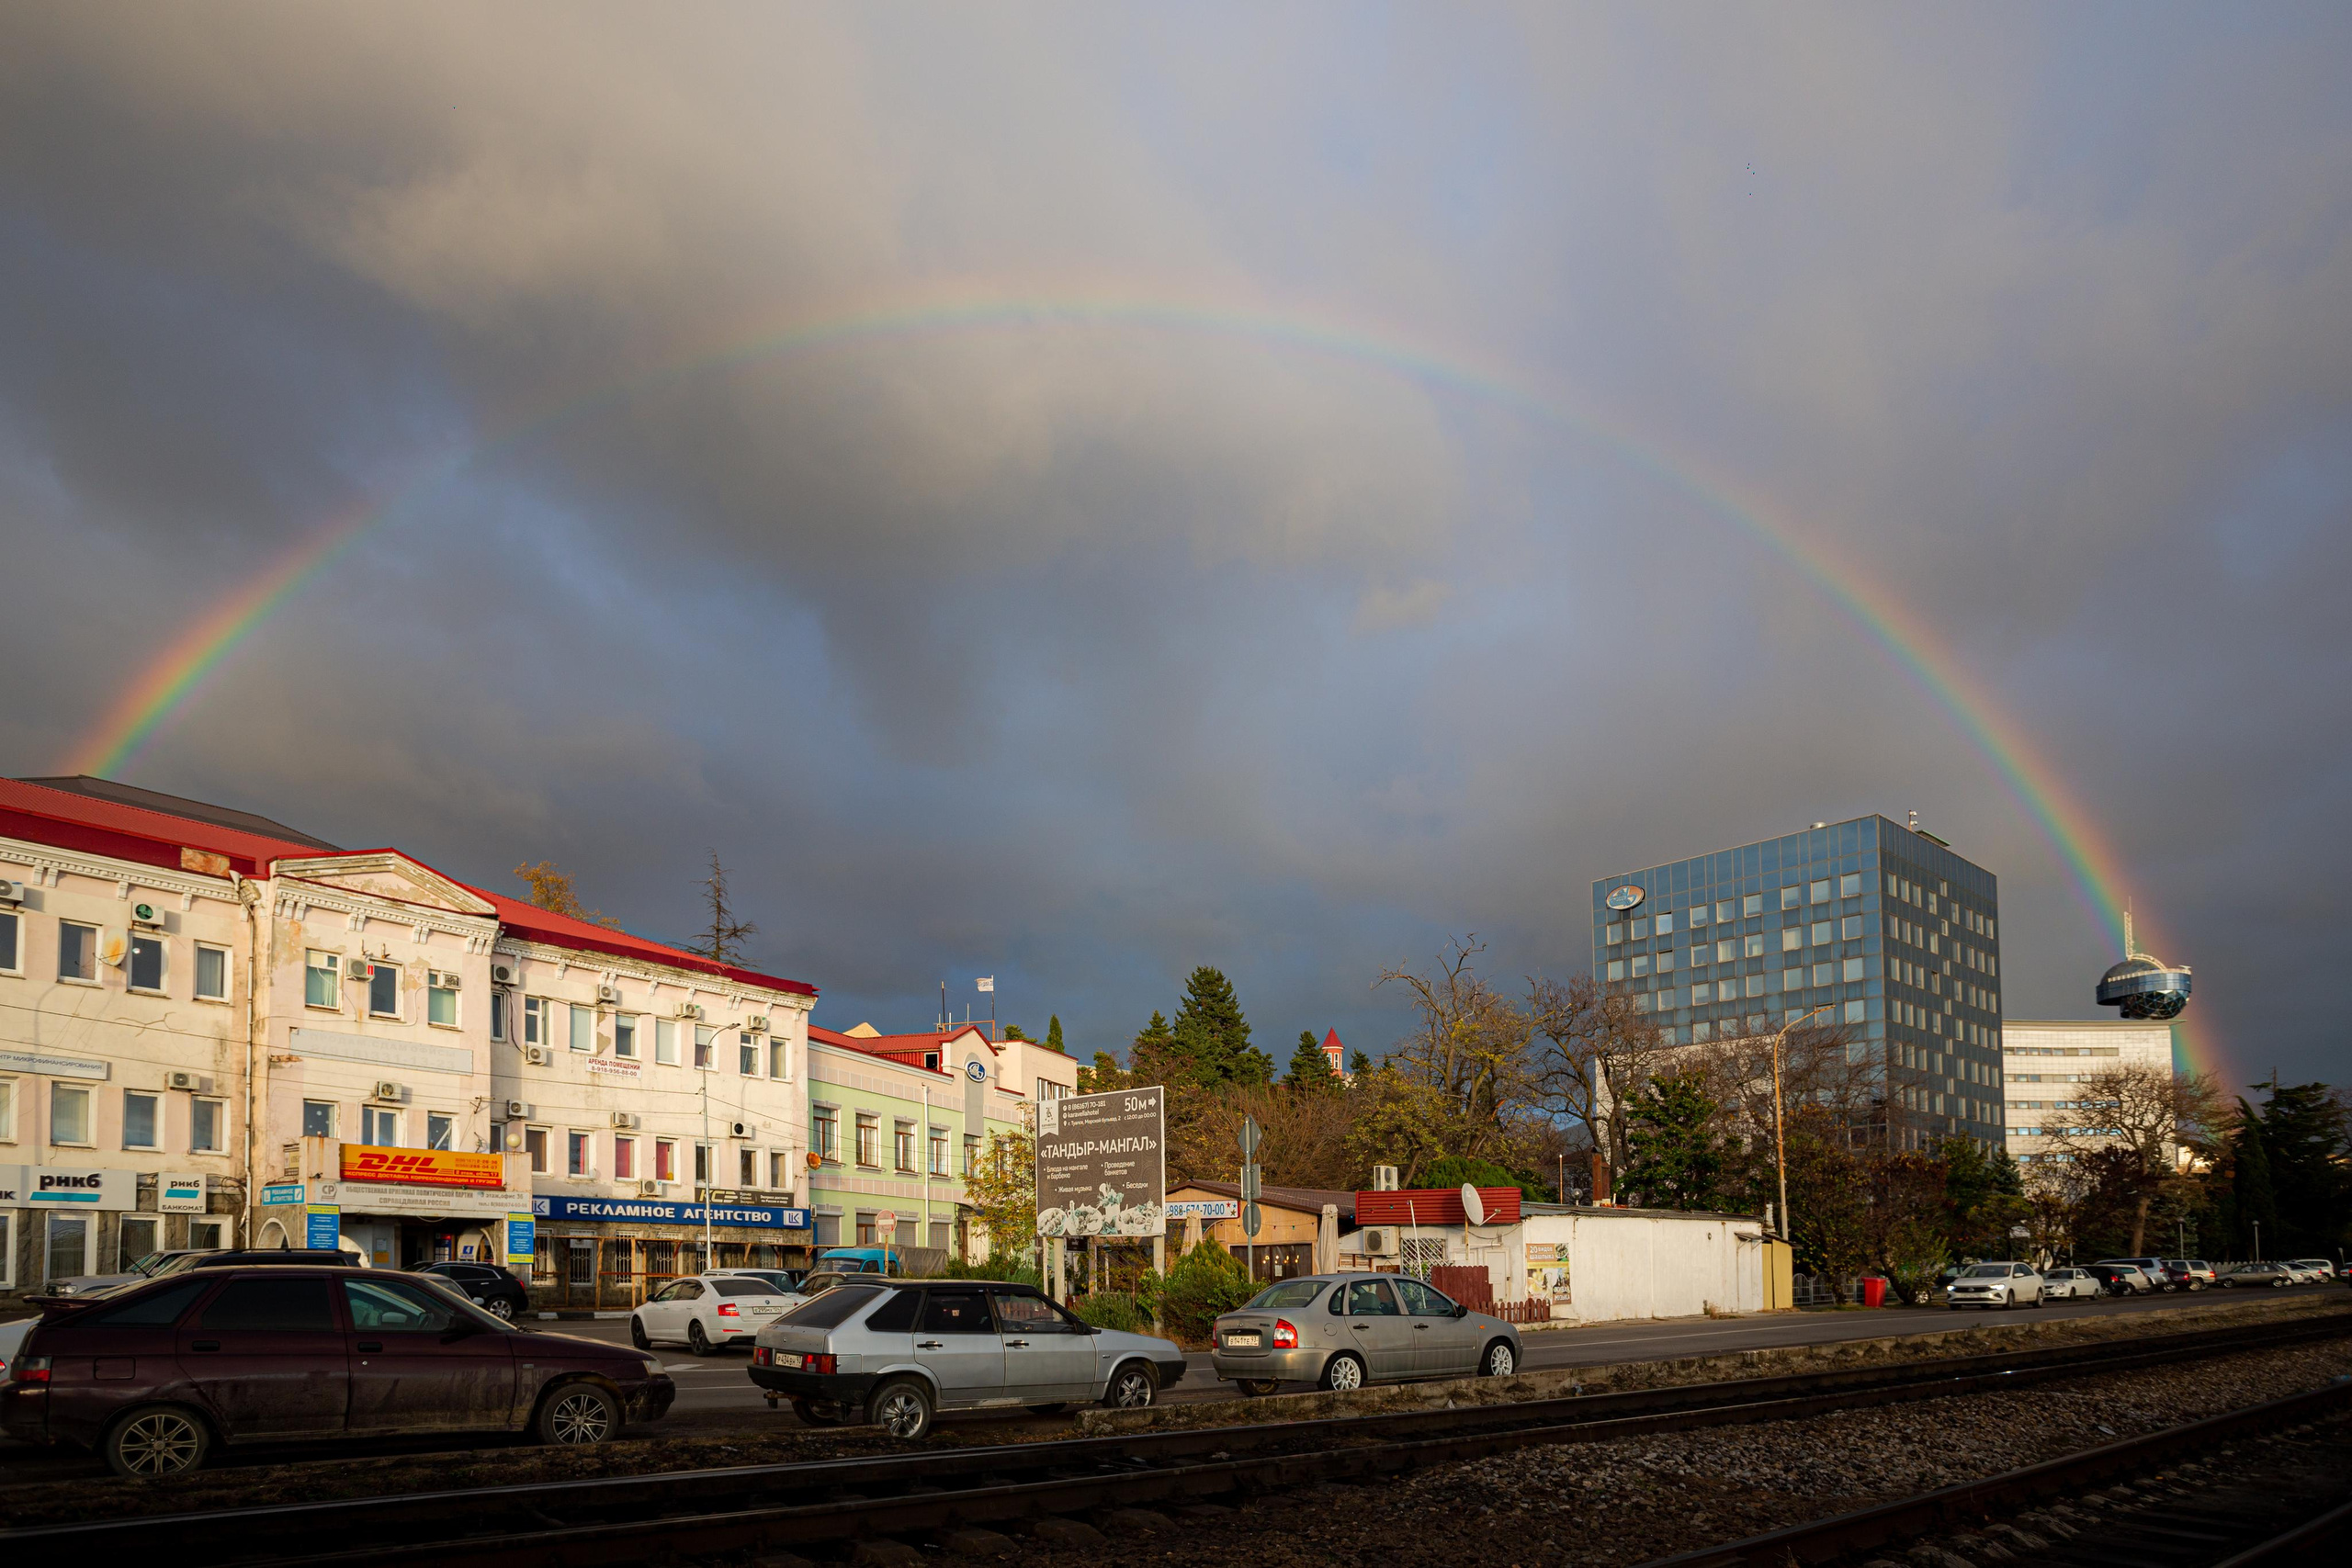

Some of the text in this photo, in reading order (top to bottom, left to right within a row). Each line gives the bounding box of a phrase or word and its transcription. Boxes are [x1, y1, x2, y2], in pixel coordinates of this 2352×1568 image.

[13, 1055, 102, 1070] МИКРОФИНАНСИРОВАНИЯ
[588, 1058, 640, 1070] АРЕНДА ПОМЕЩЕНИЙ
[1040, 1136, 1157, 1159] «ТАНДЫР-МАНГАЛ»
[357, 1153, 439, 1174] DHL
[1104, 1160, 1135, 1169] Проведение
[1050, 1172, 1071, 1180] барбекю
[1104, 1168, 1127, 1176] банкетов
[345, 1186, 387, 1194] ОБЩЕСТВЕННАЯ
[379, 1197, 426, 1205] СПРАВЕДЛИВАЯ
[566, 1202, 772, 1223] РЕКЛАМНОЕ АГЕНТСТВО
[1530, 1246, 1538, 1254] 20
